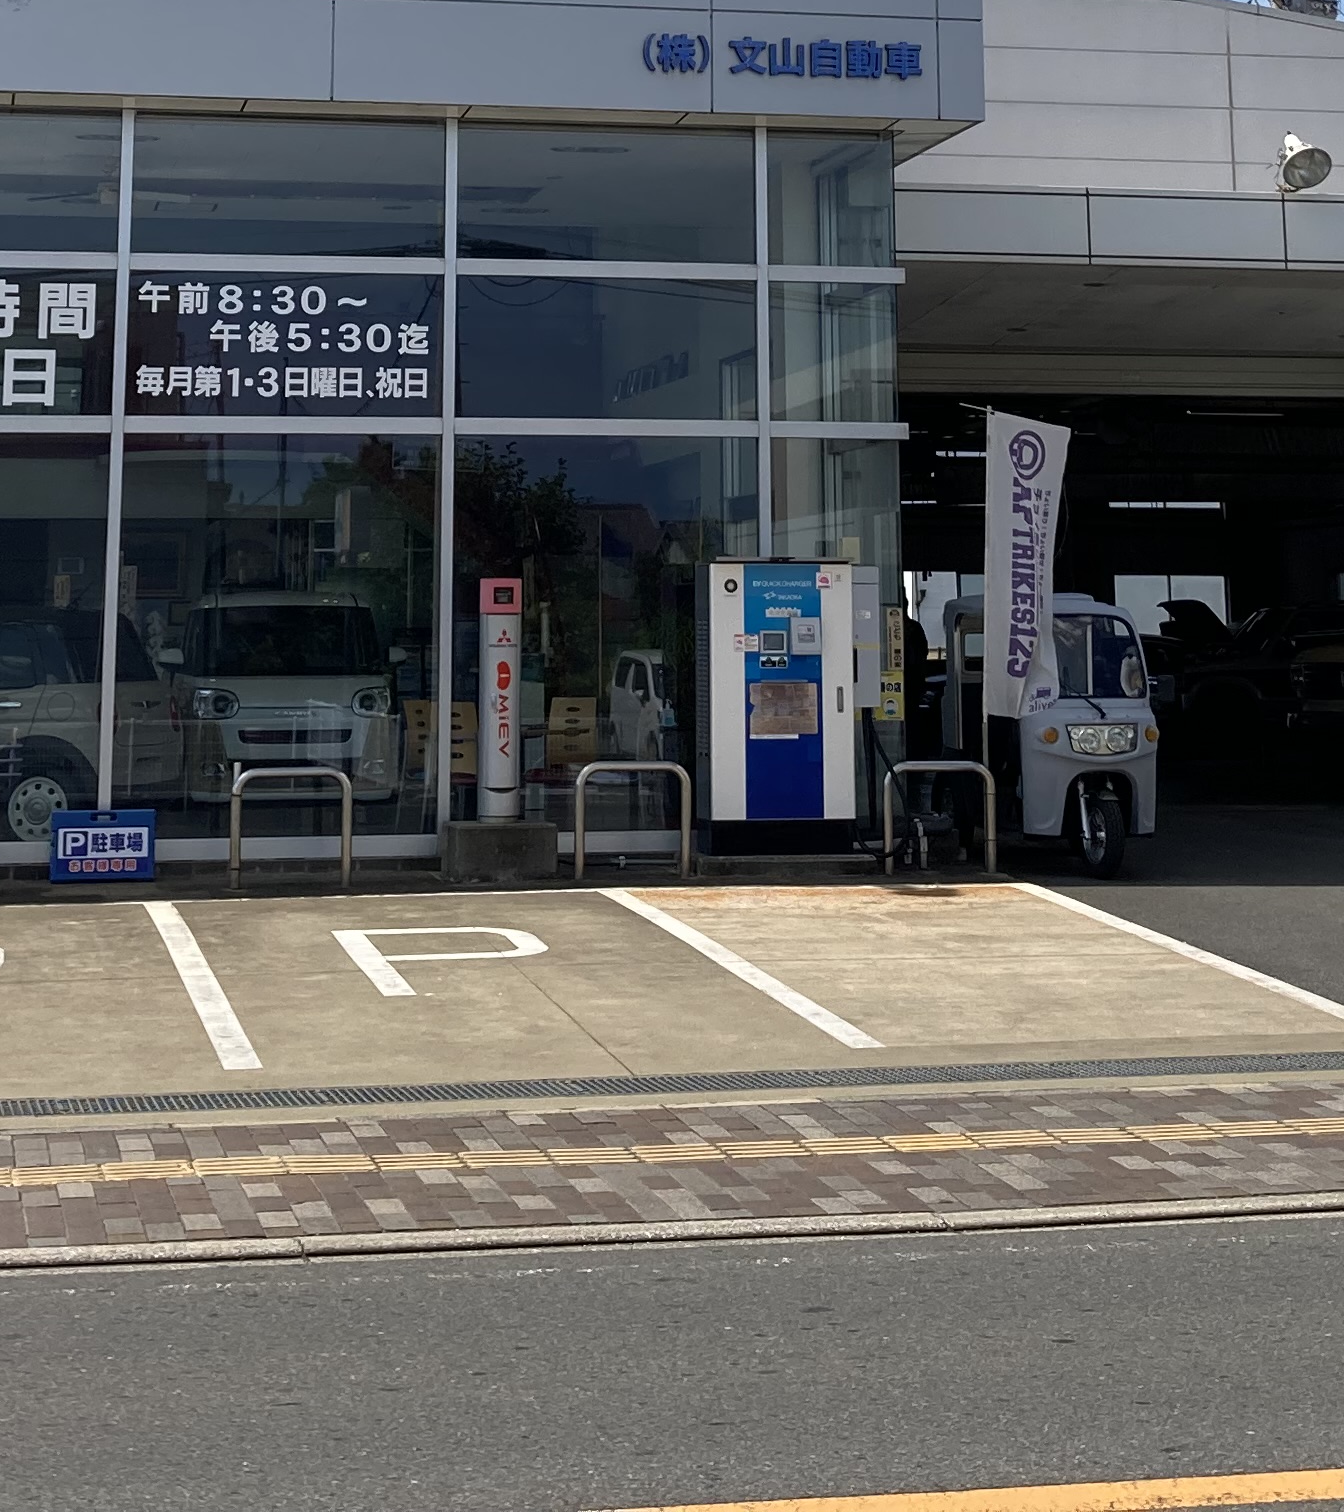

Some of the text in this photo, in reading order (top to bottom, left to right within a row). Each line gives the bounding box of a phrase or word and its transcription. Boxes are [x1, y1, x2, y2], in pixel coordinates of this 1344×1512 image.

[209, 319, 430, 356] 午後5:30迄
[90, 833, 143, 853] 駐車場
[69, 859, 137, 872] お客様専用
[331, 926, 548, 996] P
